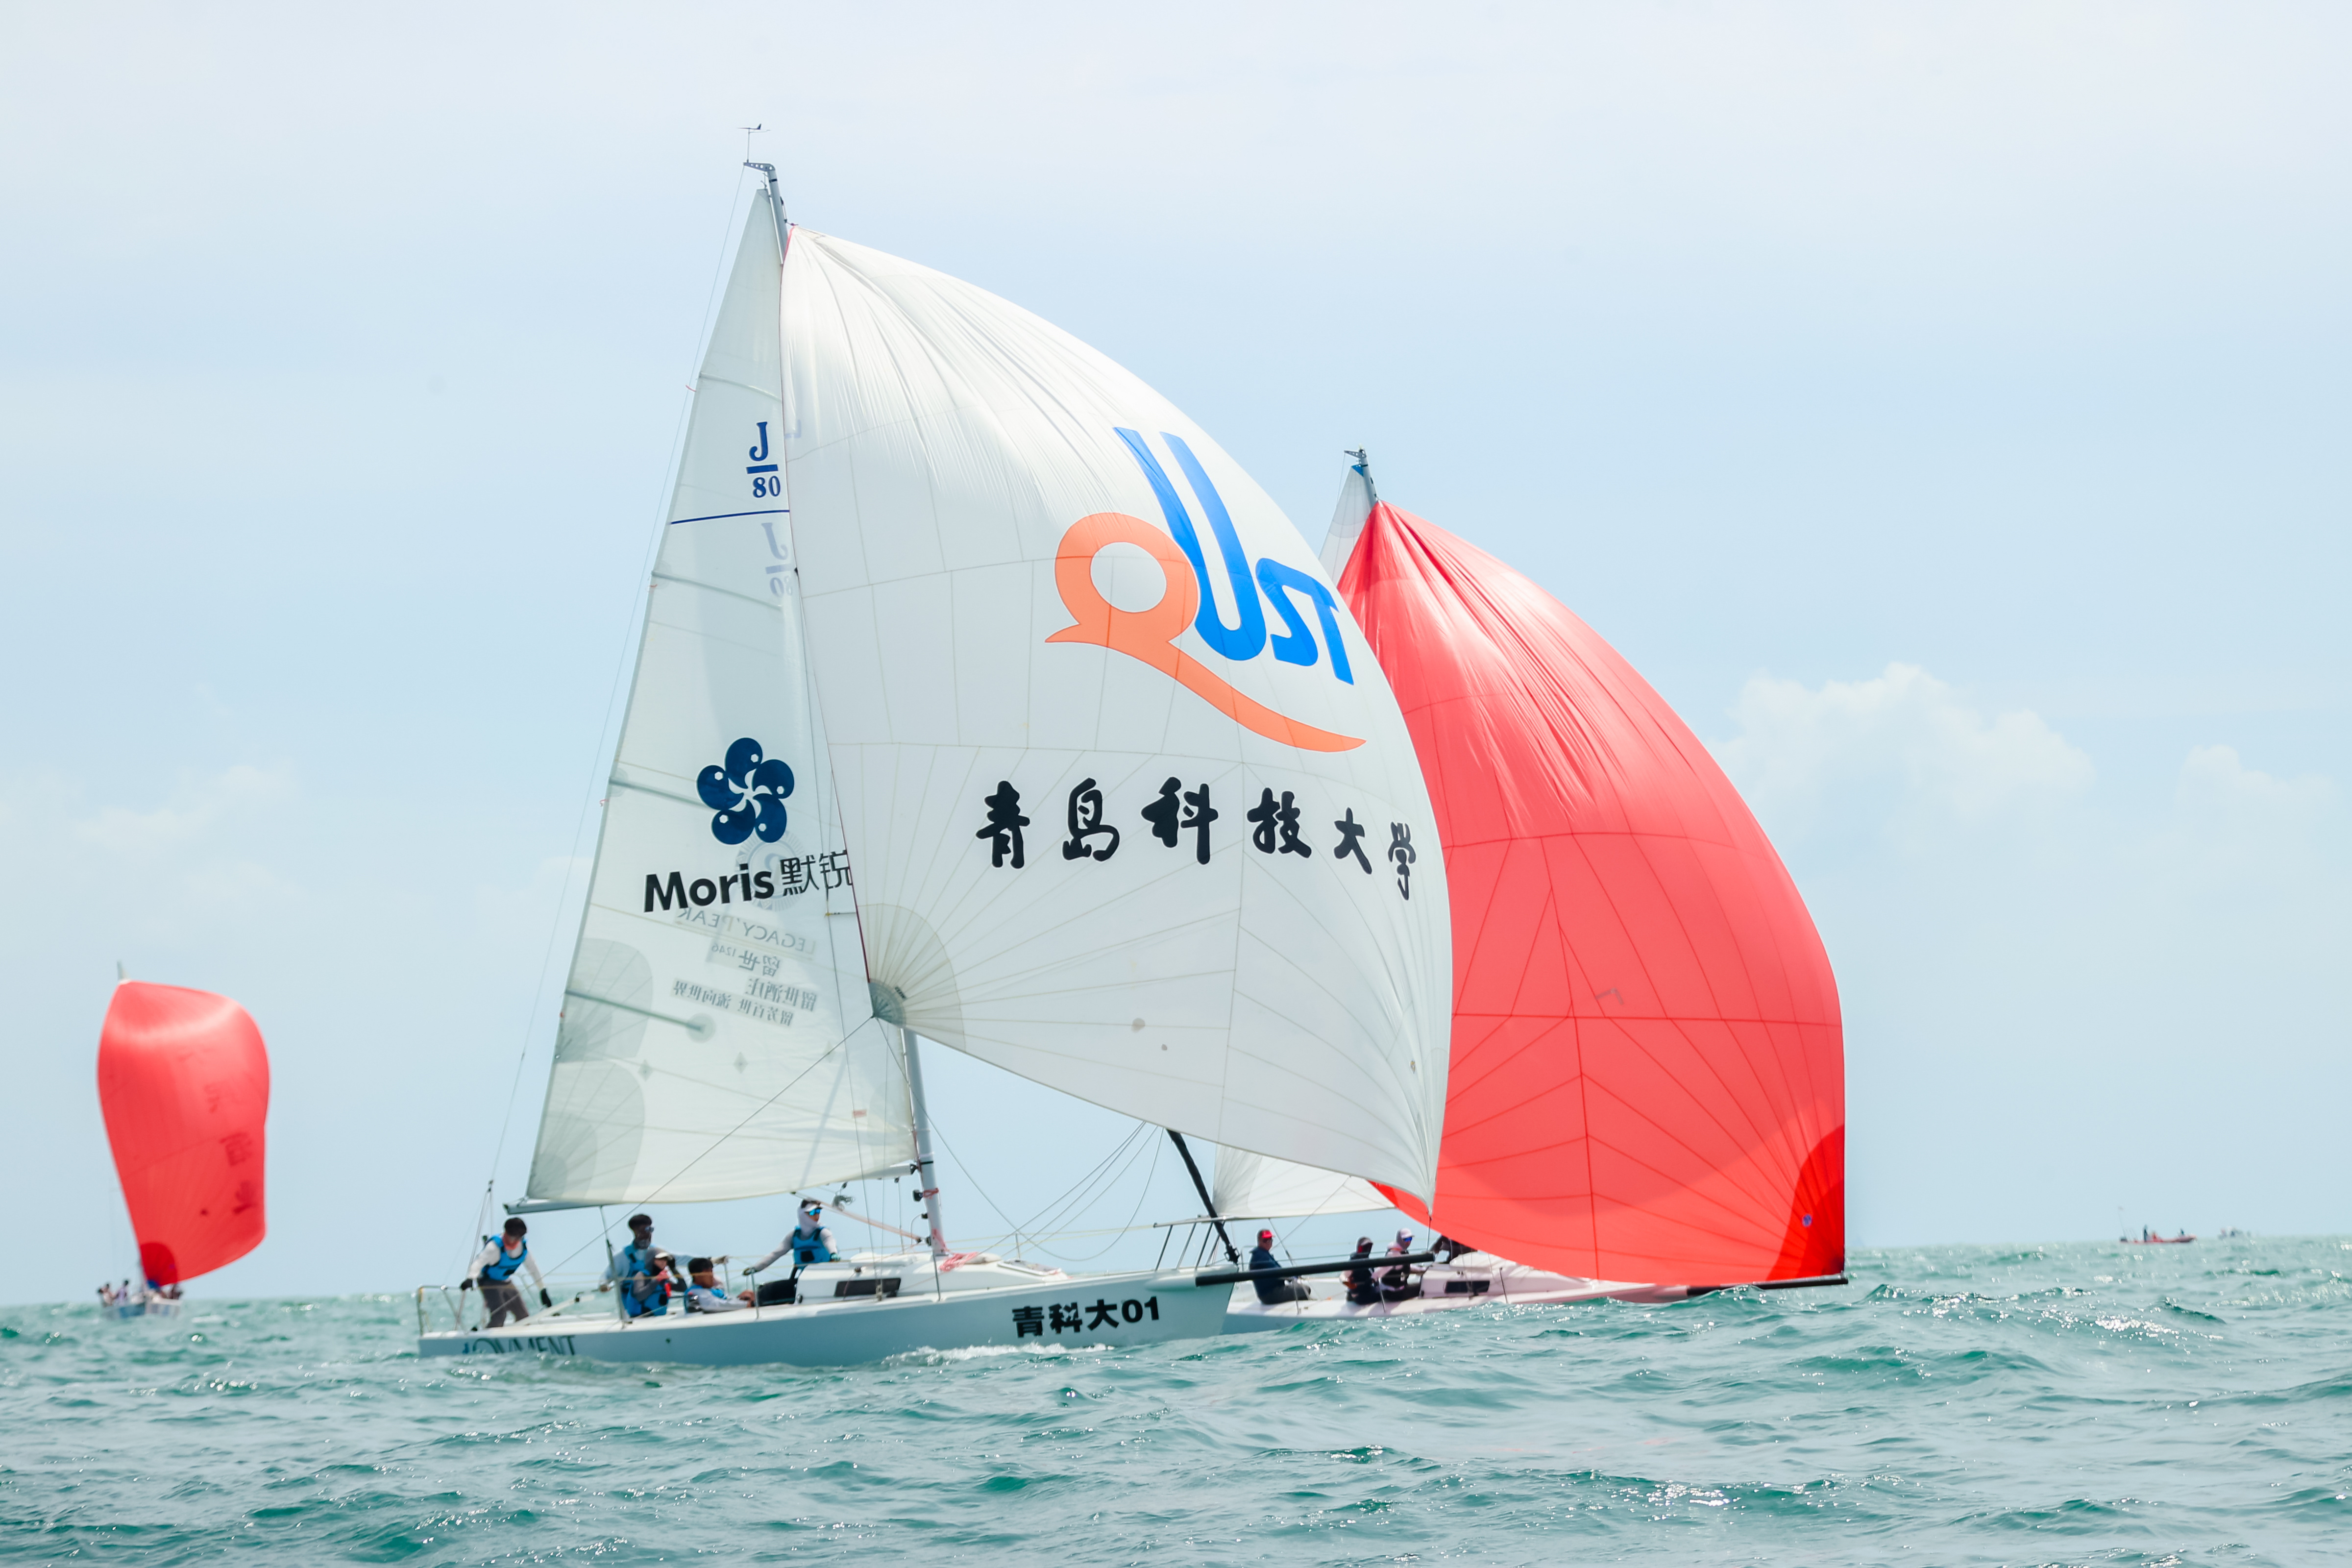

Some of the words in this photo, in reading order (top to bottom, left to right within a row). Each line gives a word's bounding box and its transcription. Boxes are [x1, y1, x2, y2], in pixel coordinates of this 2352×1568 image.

[749, 421, 768, 462] J
[752, 475, 781, 498] 80
[643, 863, 775, 913] Moris
[1012, 1296, 1160, 1338] 青科大01
